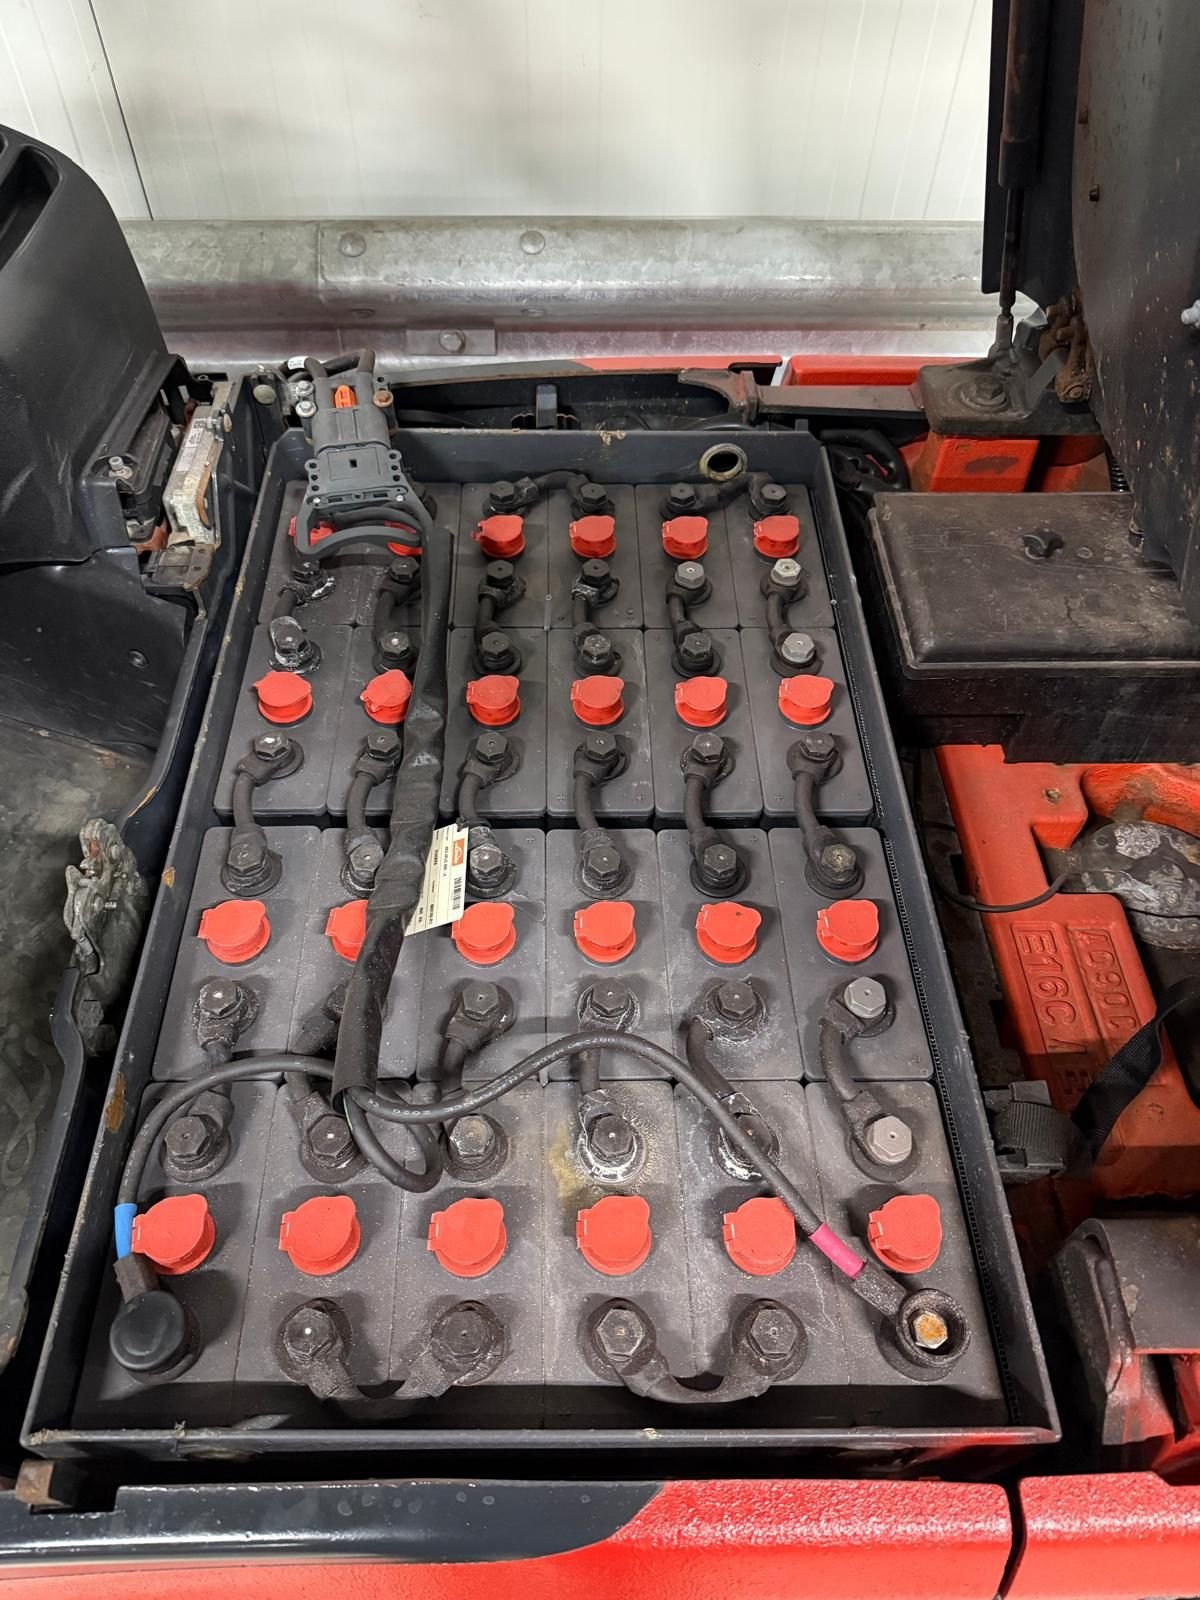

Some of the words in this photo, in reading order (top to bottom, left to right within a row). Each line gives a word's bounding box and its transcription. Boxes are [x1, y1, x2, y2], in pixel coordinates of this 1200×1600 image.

[1019, 930, 1076, 1026] E16C
[532, 1048, 565, 1067] MADE
[508, 1071, 525, 1084] IN
[391, 1108, 432, 1117] 2020
